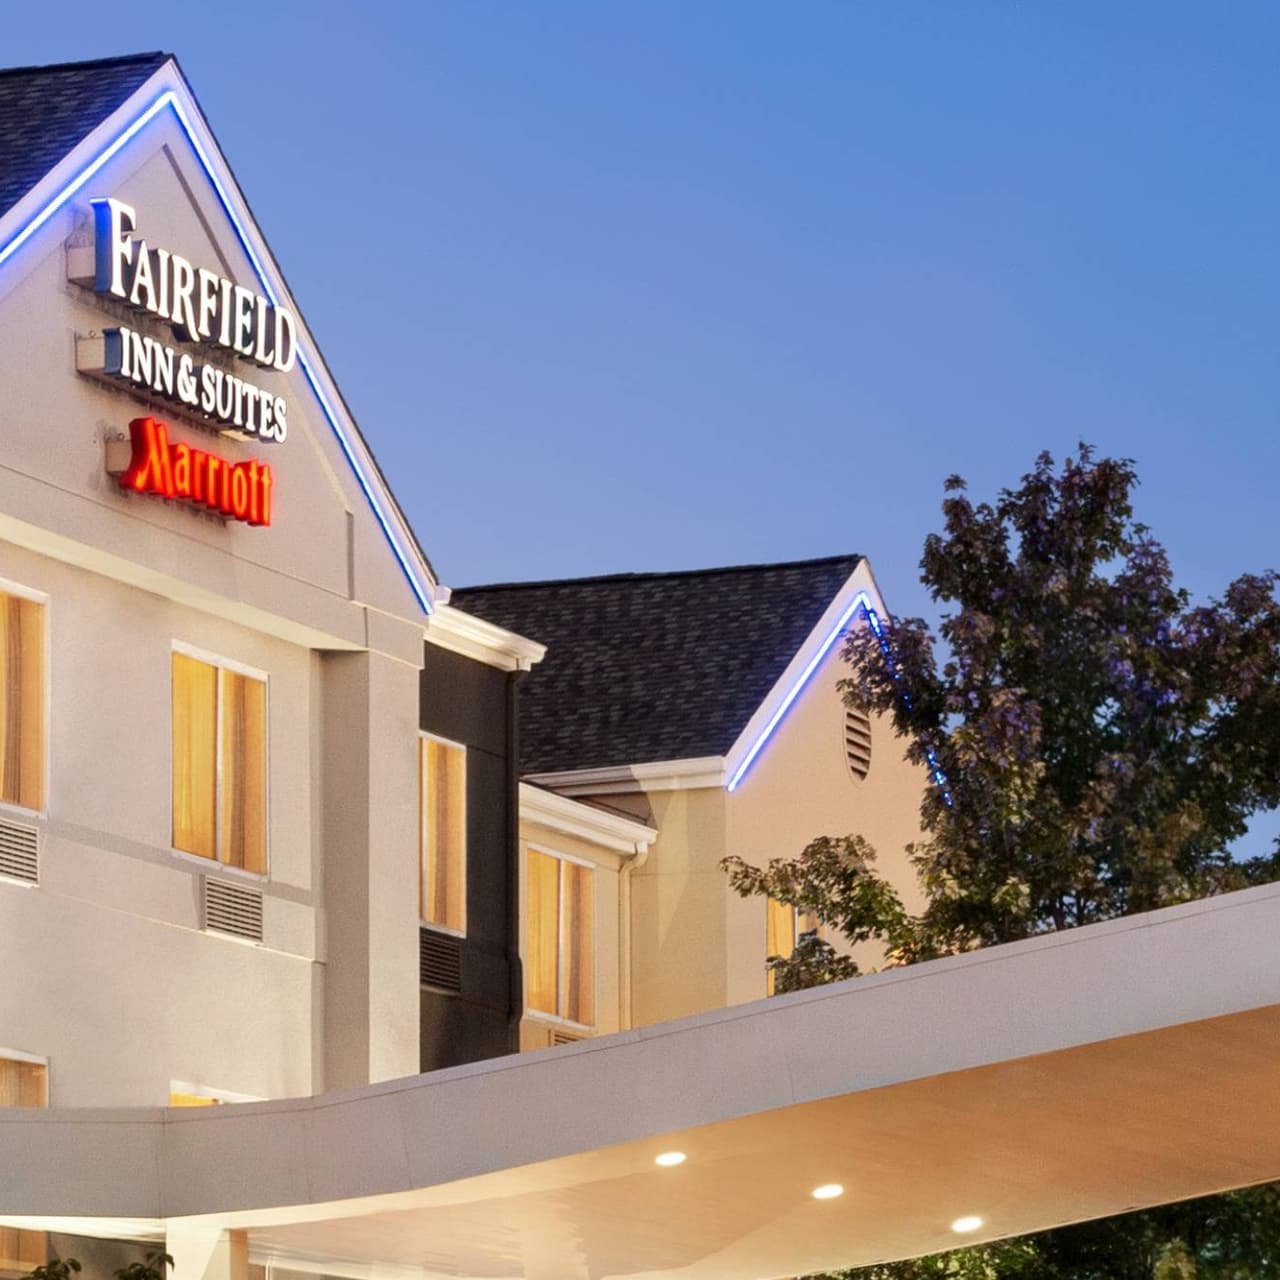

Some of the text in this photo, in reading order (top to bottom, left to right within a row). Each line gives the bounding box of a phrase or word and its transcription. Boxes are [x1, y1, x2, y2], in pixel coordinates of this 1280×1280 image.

[107, 198, 297, 373] FAIRFIELD
[119, 326, 174, 396] INN
[202, 366, 288, 443] SUITES
[133, 417, 272, 526] Marriott
